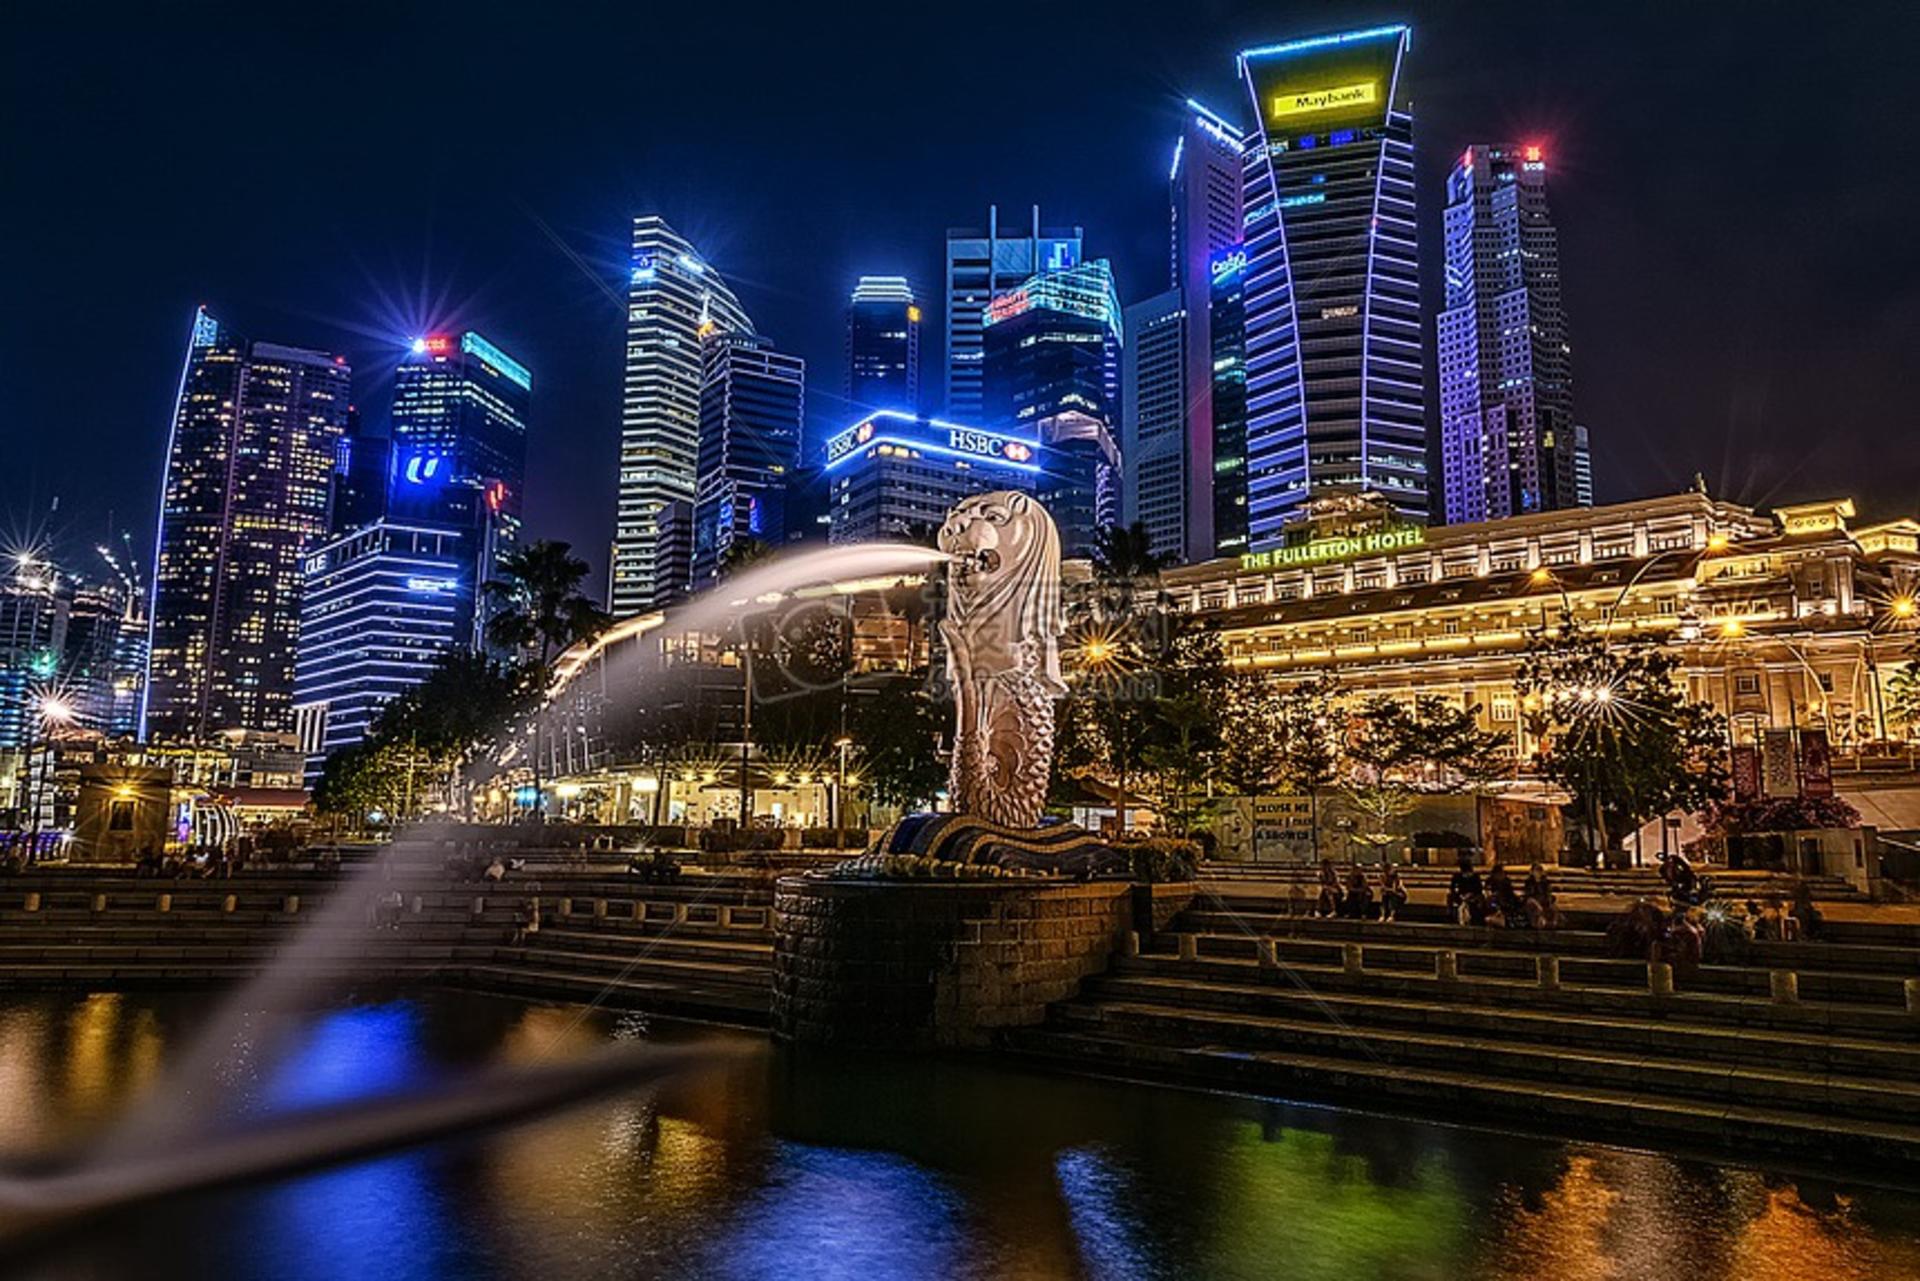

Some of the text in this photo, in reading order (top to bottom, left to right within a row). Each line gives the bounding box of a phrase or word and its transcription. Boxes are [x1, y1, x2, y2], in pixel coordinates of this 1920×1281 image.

[1296, 88, 1365, 108] Maybank
[949, 429, 1003, 457] HSBC
[1240, 525, 1425, 570] THE FULLERTON HOTEL
